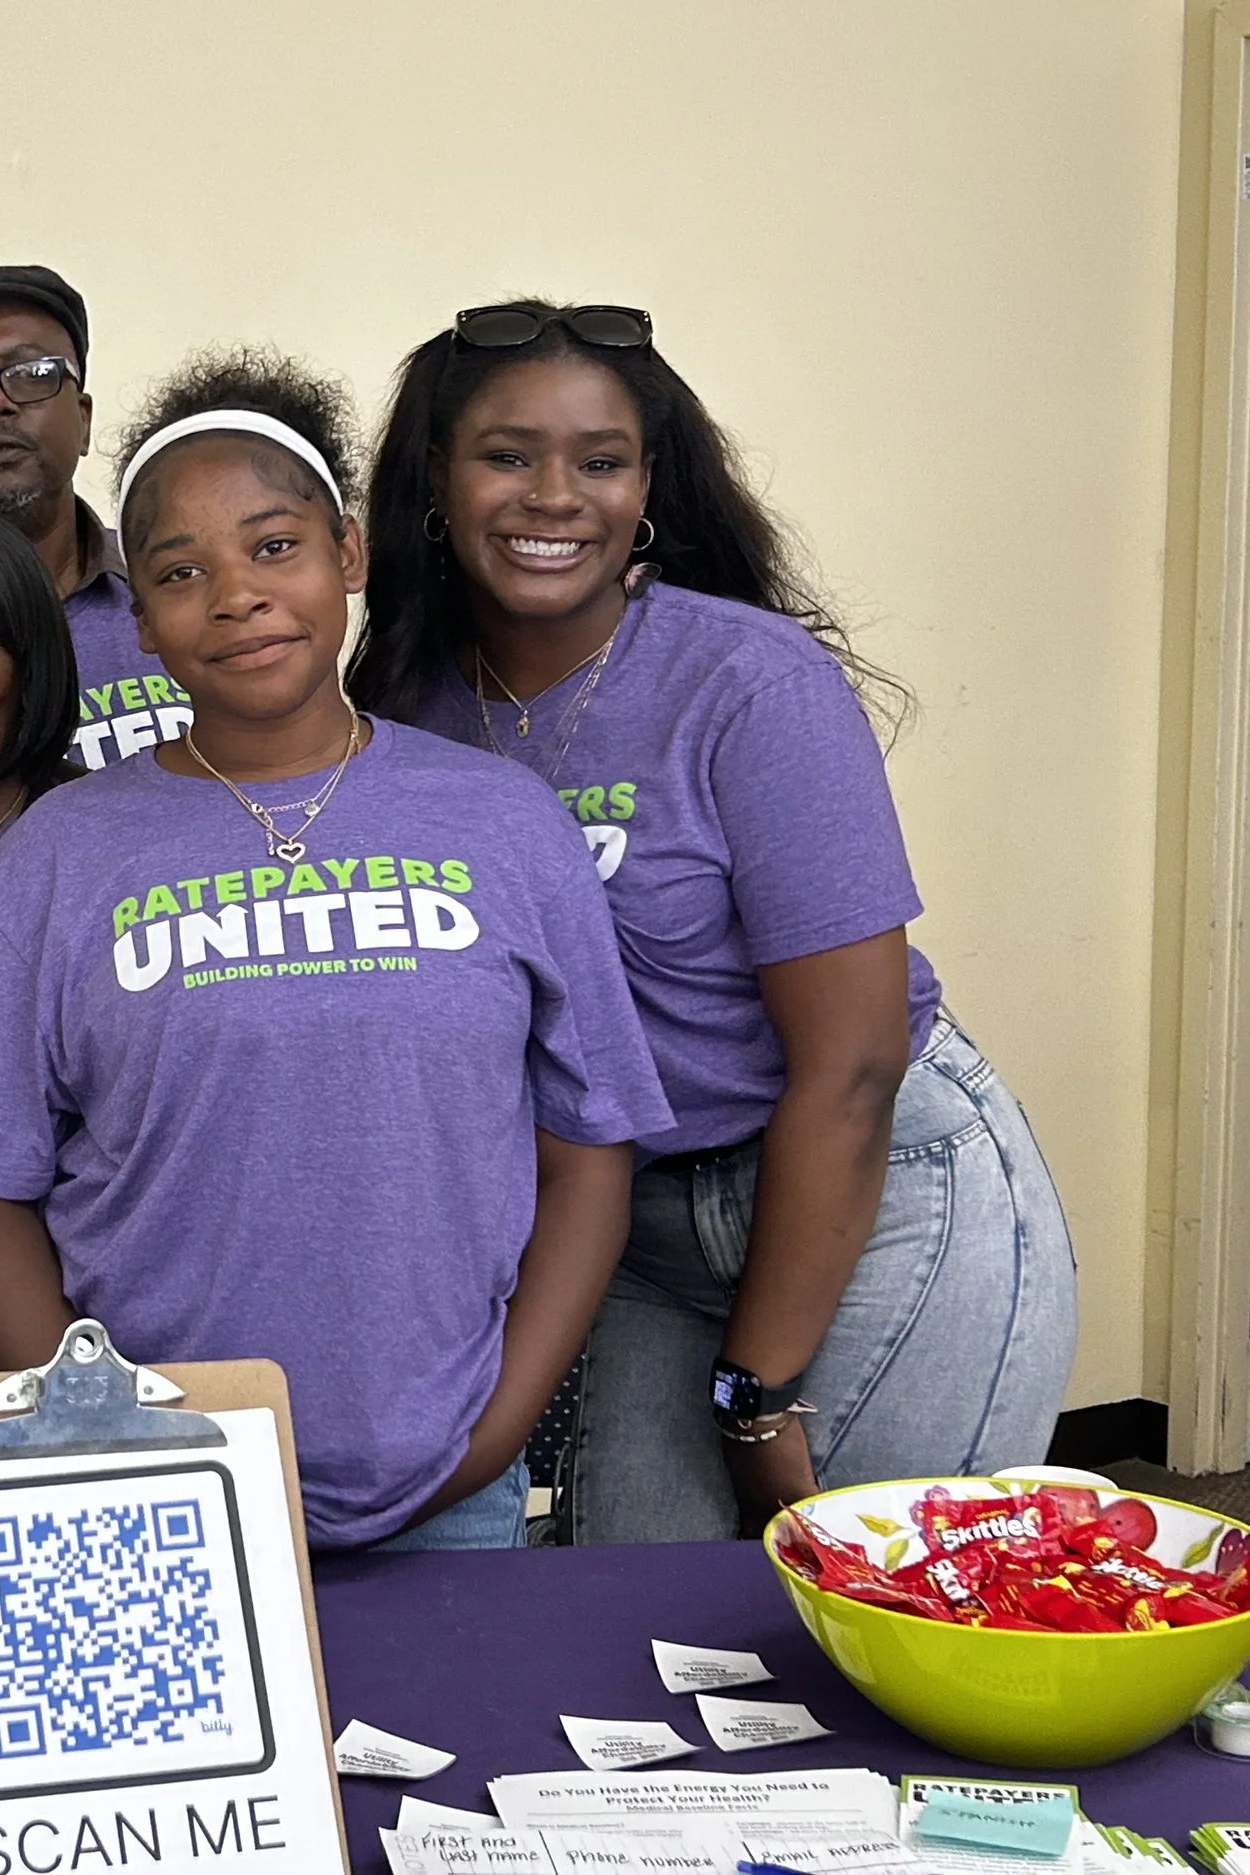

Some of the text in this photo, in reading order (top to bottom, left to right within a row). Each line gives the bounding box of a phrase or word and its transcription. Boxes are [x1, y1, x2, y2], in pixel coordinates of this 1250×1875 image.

[112, 856, 473, 938] RATEPAYERS
[113, 888, 480, 992] UNITED
[183, 956, 418, 989] BUILDING POWER TO WIN
[941, 1515, 1042, 1551] Skittles
[538, 1781, 831, 1798] Do You Have the Energy You Need to
[605, 1793, 771, 1806] Protect Your Health?
[185, 1794, 287, 1858] ME
